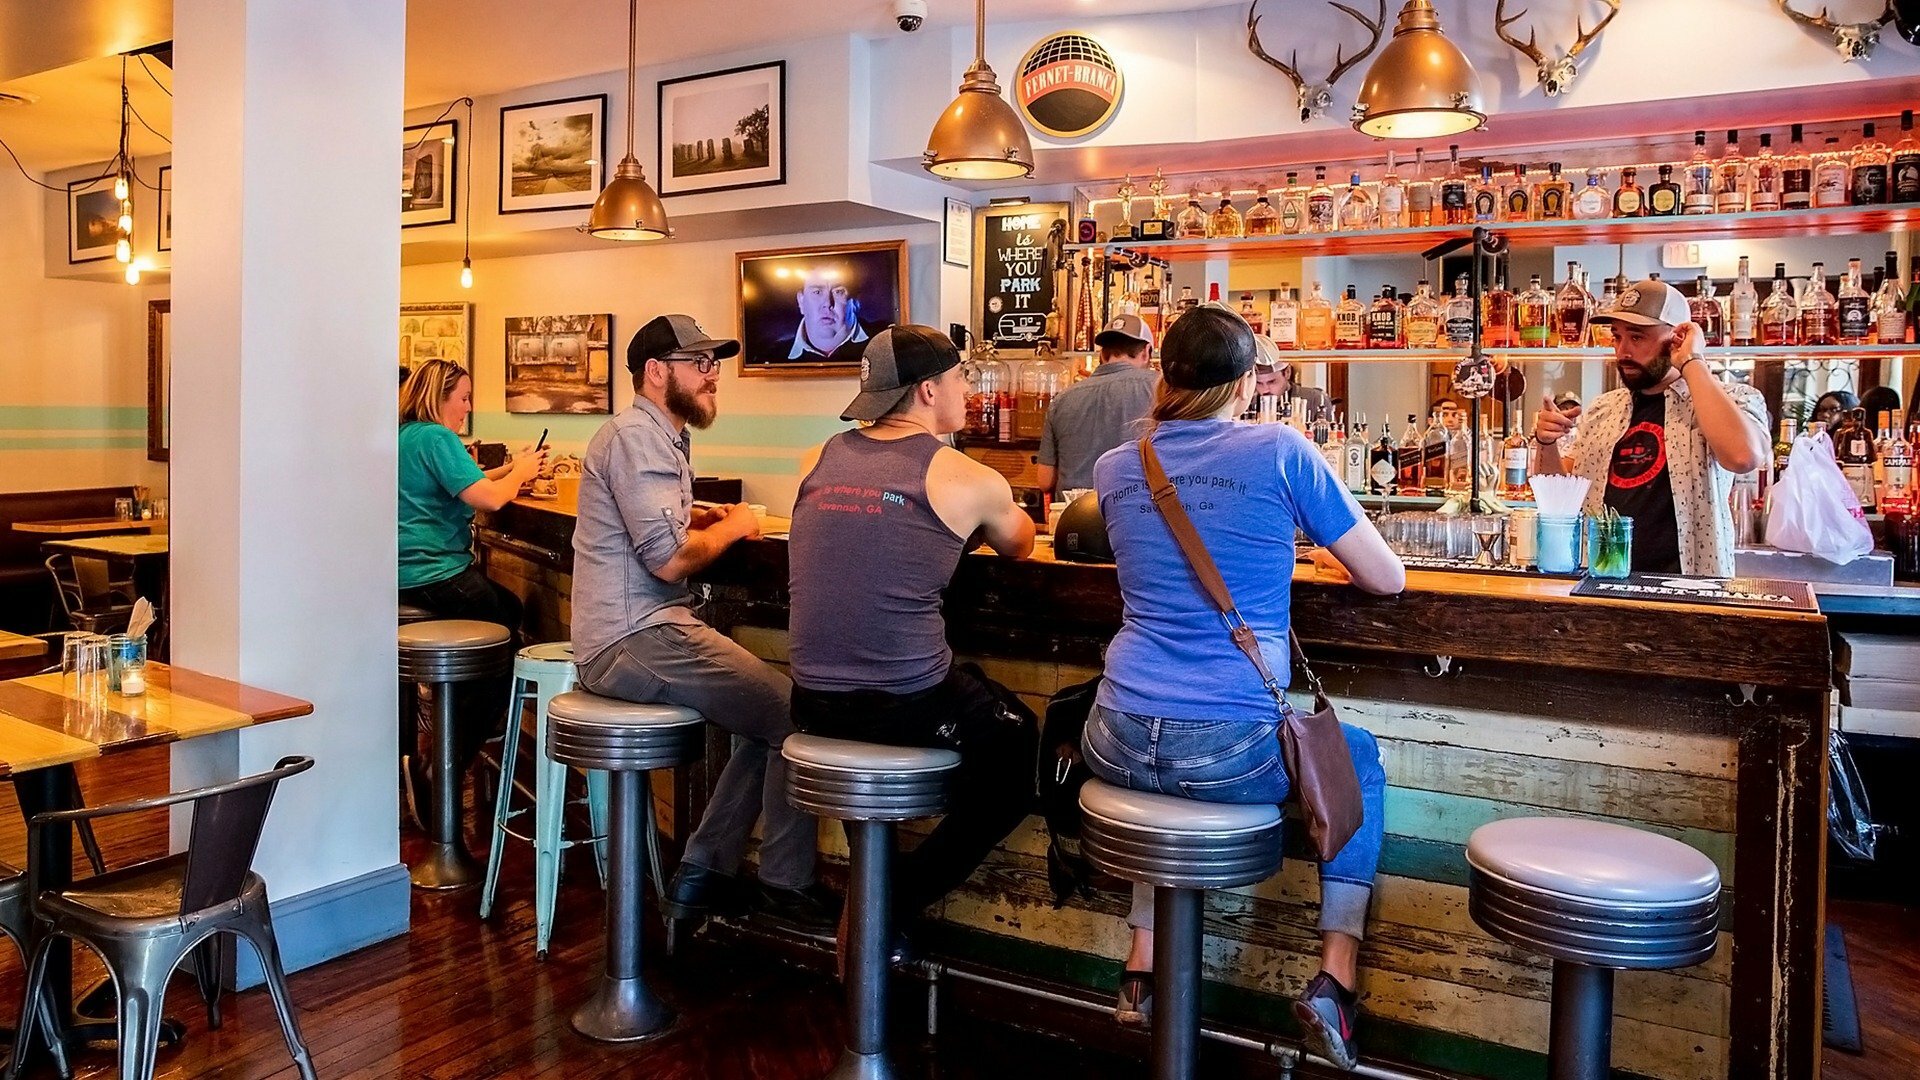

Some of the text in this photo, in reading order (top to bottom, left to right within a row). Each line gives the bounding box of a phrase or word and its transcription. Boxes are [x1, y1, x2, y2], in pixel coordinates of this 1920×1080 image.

[1025, 64, 1116, 99] FERNET-BRANCA
[1001, 216, 1042, 231] HOME
[1015, 232, 1035, 247] is
[998, 246, 1043, 262] WHERE
[1005, 261, 1038, 277] YOU
[1000, 277, 1042, 293] PARK
[1014, 293, 1031, 309] IT
[1336, 312, 1356, 322] KNOB
[1371, 312, 1391, 322] KNOB
[862, 488, 882, 498] you
[882, 491, 905, 506] park
[1111, 482, 1139, 505] Home
[1141, 480, 1150, 490] is
[1189, 474, 1208, 487] you
[1211, 476, 1236, 490] park
[1238, 482, 1247, 496] it
[866, 504, 883, 514] GA
[1199, 500, 1214, 511] Ga
[1596, 583, 1795, 603] FERNET-BRANCA
